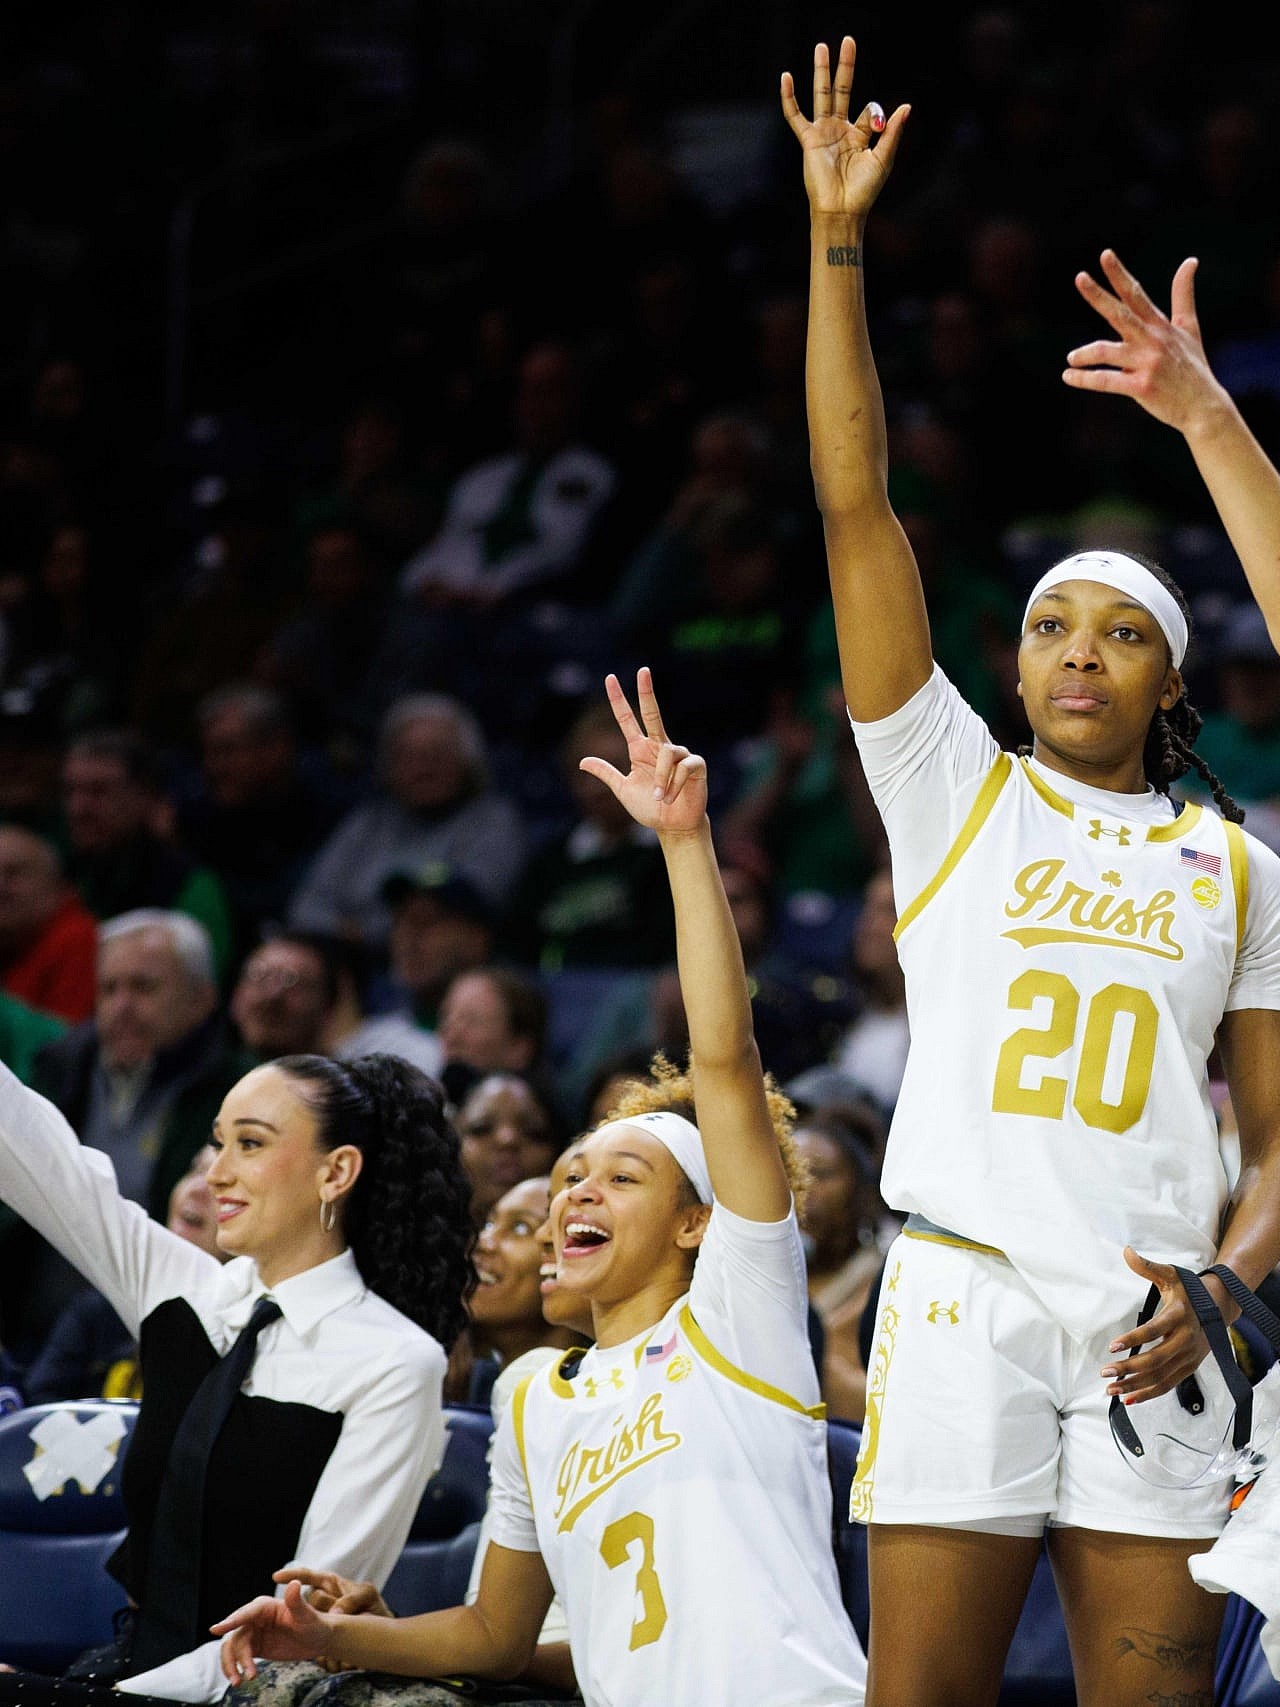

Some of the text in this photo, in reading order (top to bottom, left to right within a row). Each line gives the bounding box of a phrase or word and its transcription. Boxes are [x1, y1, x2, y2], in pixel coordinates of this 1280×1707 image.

[1003, 858, 1179, 945] Irish
[991, 968, 1160, 1136] 20
[553, 1392, 672, 1519] Irish
[599, 1511, 668, 1652] 3
